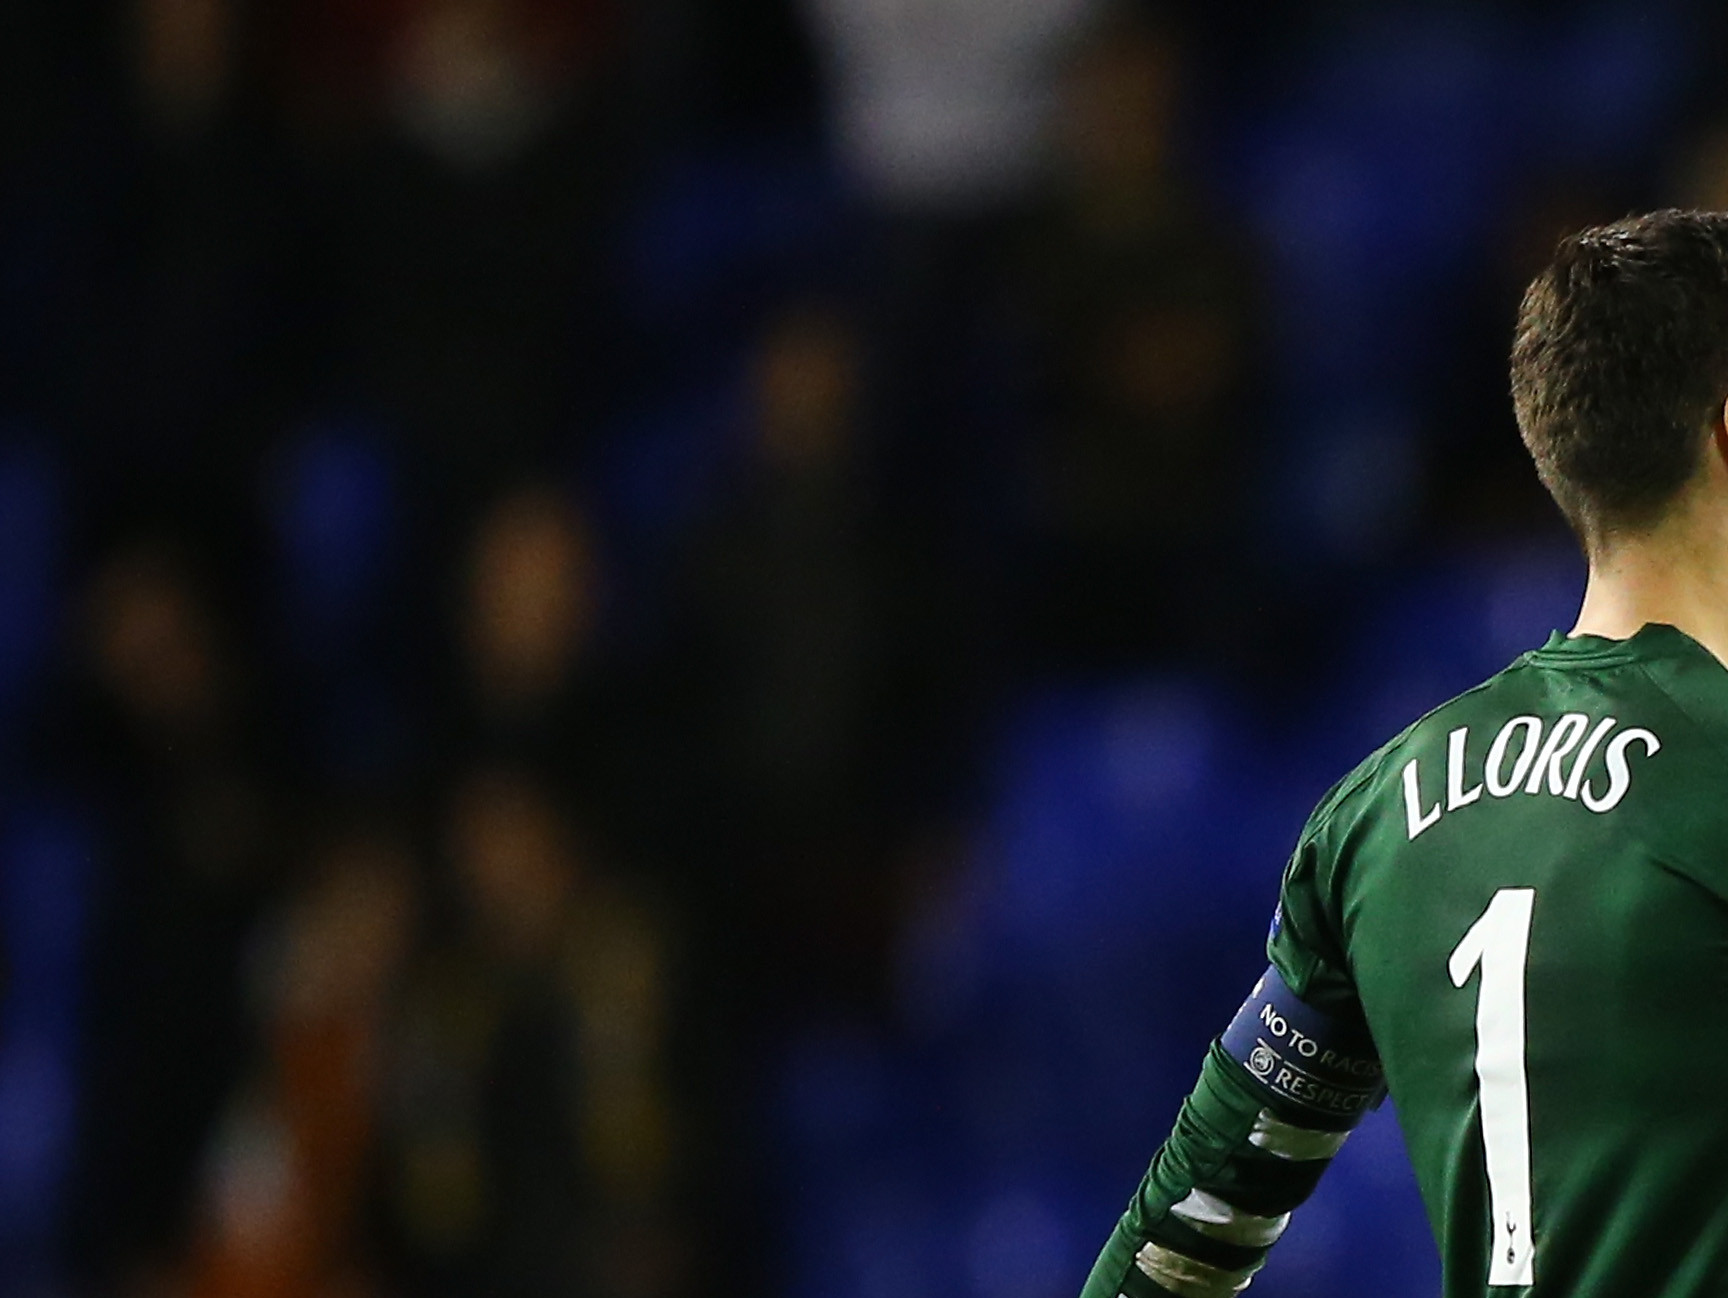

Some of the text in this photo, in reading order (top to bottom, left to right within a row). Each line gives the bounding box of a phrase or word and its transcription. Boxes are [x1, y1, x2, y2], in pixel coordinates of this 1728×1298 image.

[1401, 713, 1661, 841] LLORIS
[1259, 1003, 1382, 1078] NO TO RACIS
[1275, 1067, 1369, 1111] RESPECT
[1446, 887, 1536, 1286] 1
